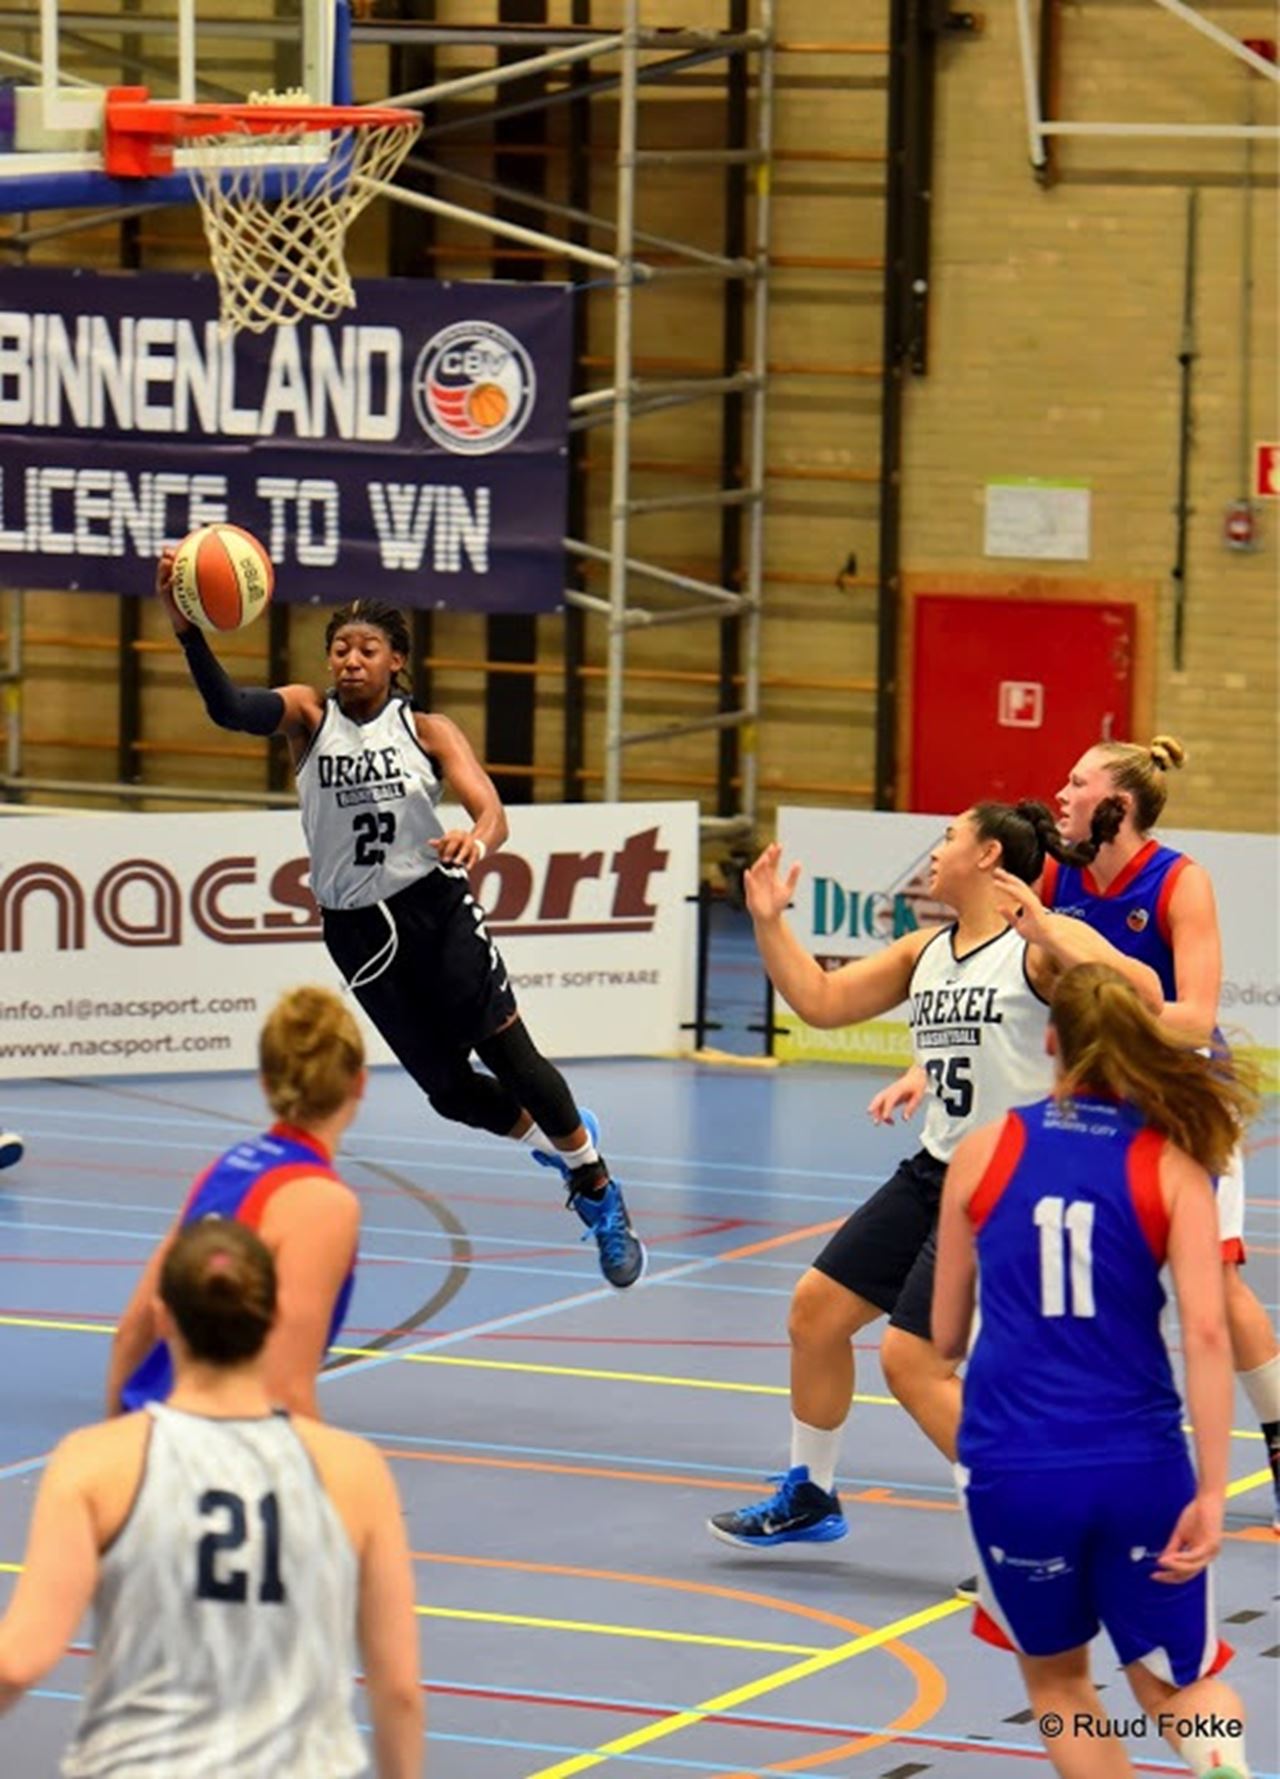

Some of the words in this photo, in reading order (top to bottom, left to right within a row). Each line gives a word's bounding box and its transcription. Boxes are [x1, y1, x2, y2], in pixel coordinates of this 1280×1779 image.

[0, 311, 402, 441] BINNENLAND
[0, 466, 227, 557] LICENCE
[256, 477, 339, 566] TO
[368, 482, 491, 574] WIN
[0, 826, 669, 953] nacsort
[0, 996, 257, 1021] info.nl@nacsport.com
[560, 969, 659, 988] SOFTWARE
[0, 1035, 231, 1058] www.nacsport.com
[1033, 1196, 1095, 1319] 11
[196, 1490, 285, 1604] 21
